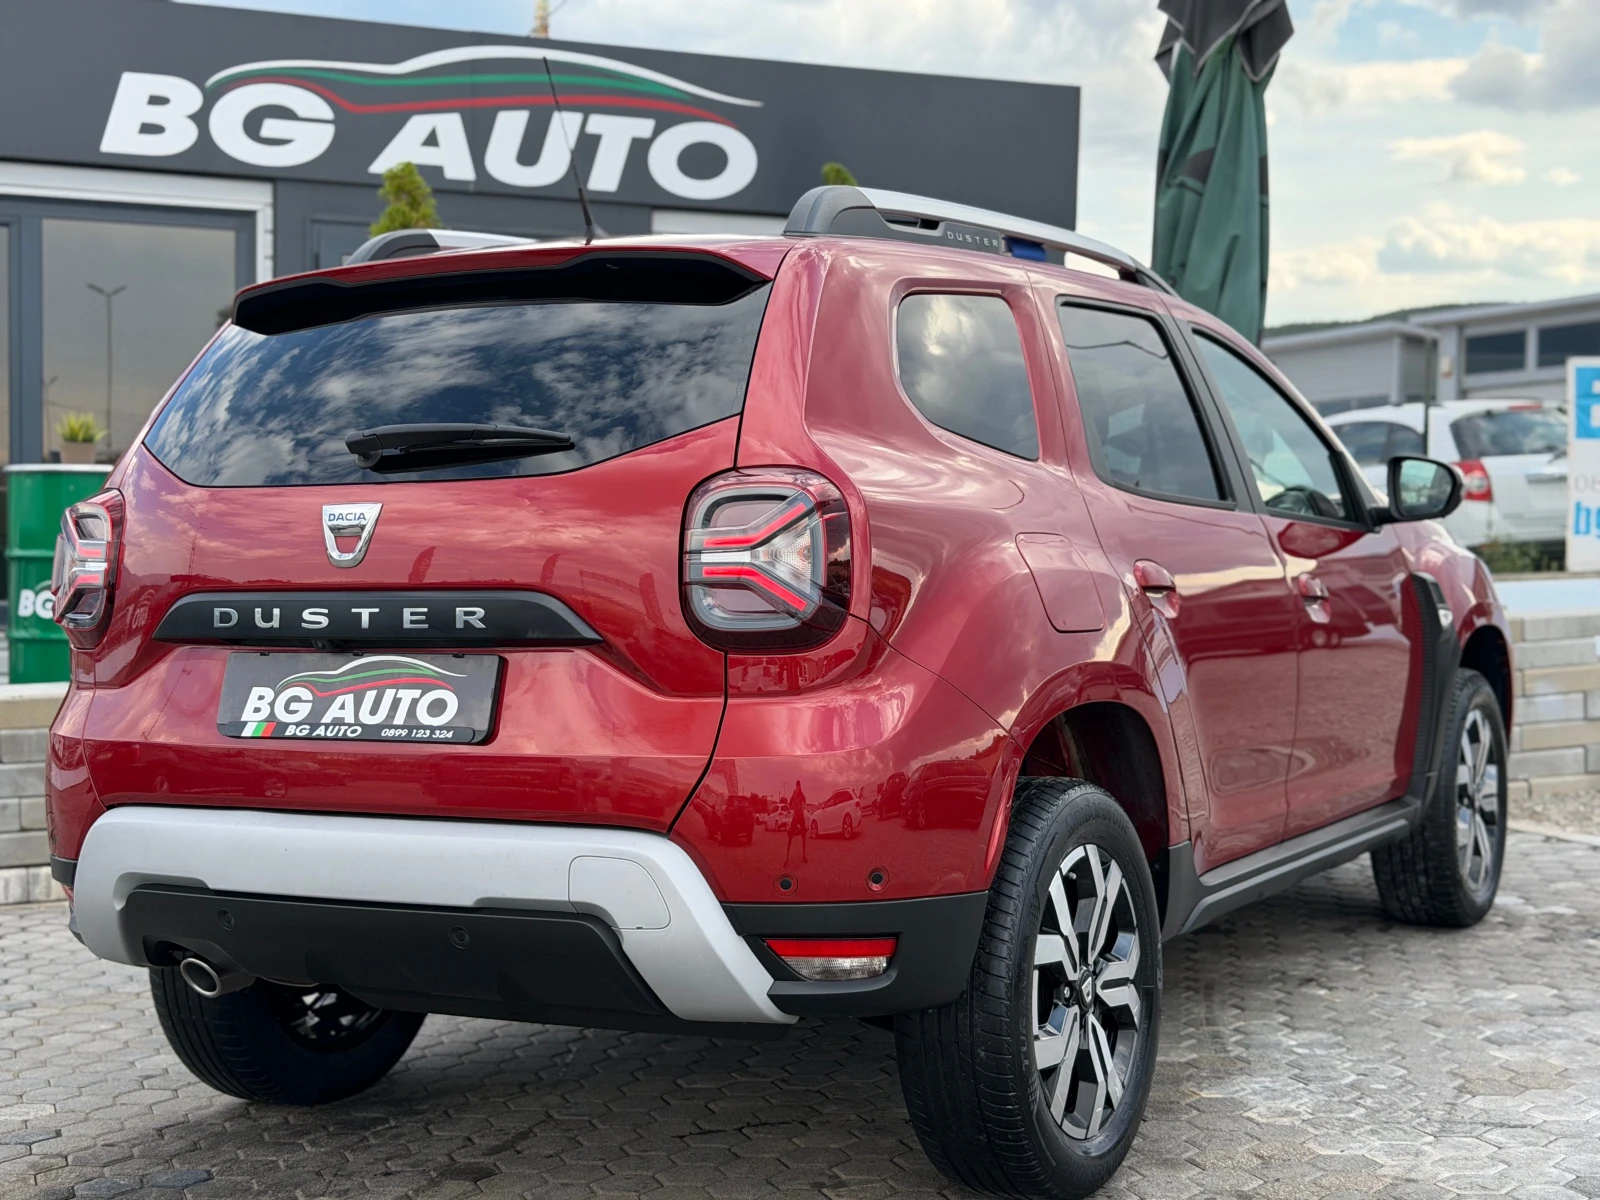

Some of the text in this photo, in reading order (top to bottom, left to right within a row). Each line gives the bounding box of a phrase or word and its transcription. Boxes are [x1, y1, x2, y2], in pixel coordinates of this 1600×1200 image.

[100, 72, 758, 200] BG AUTO
[947, 231, 998, 248] DUSTER
[328, 512, 366, 522] DACIA
[213, 607, 486, 630] DUSTER
[241, 687, 459, 726] BG AUTO
[284, 724, 454, 739] BG AUTO 0899 123 324
